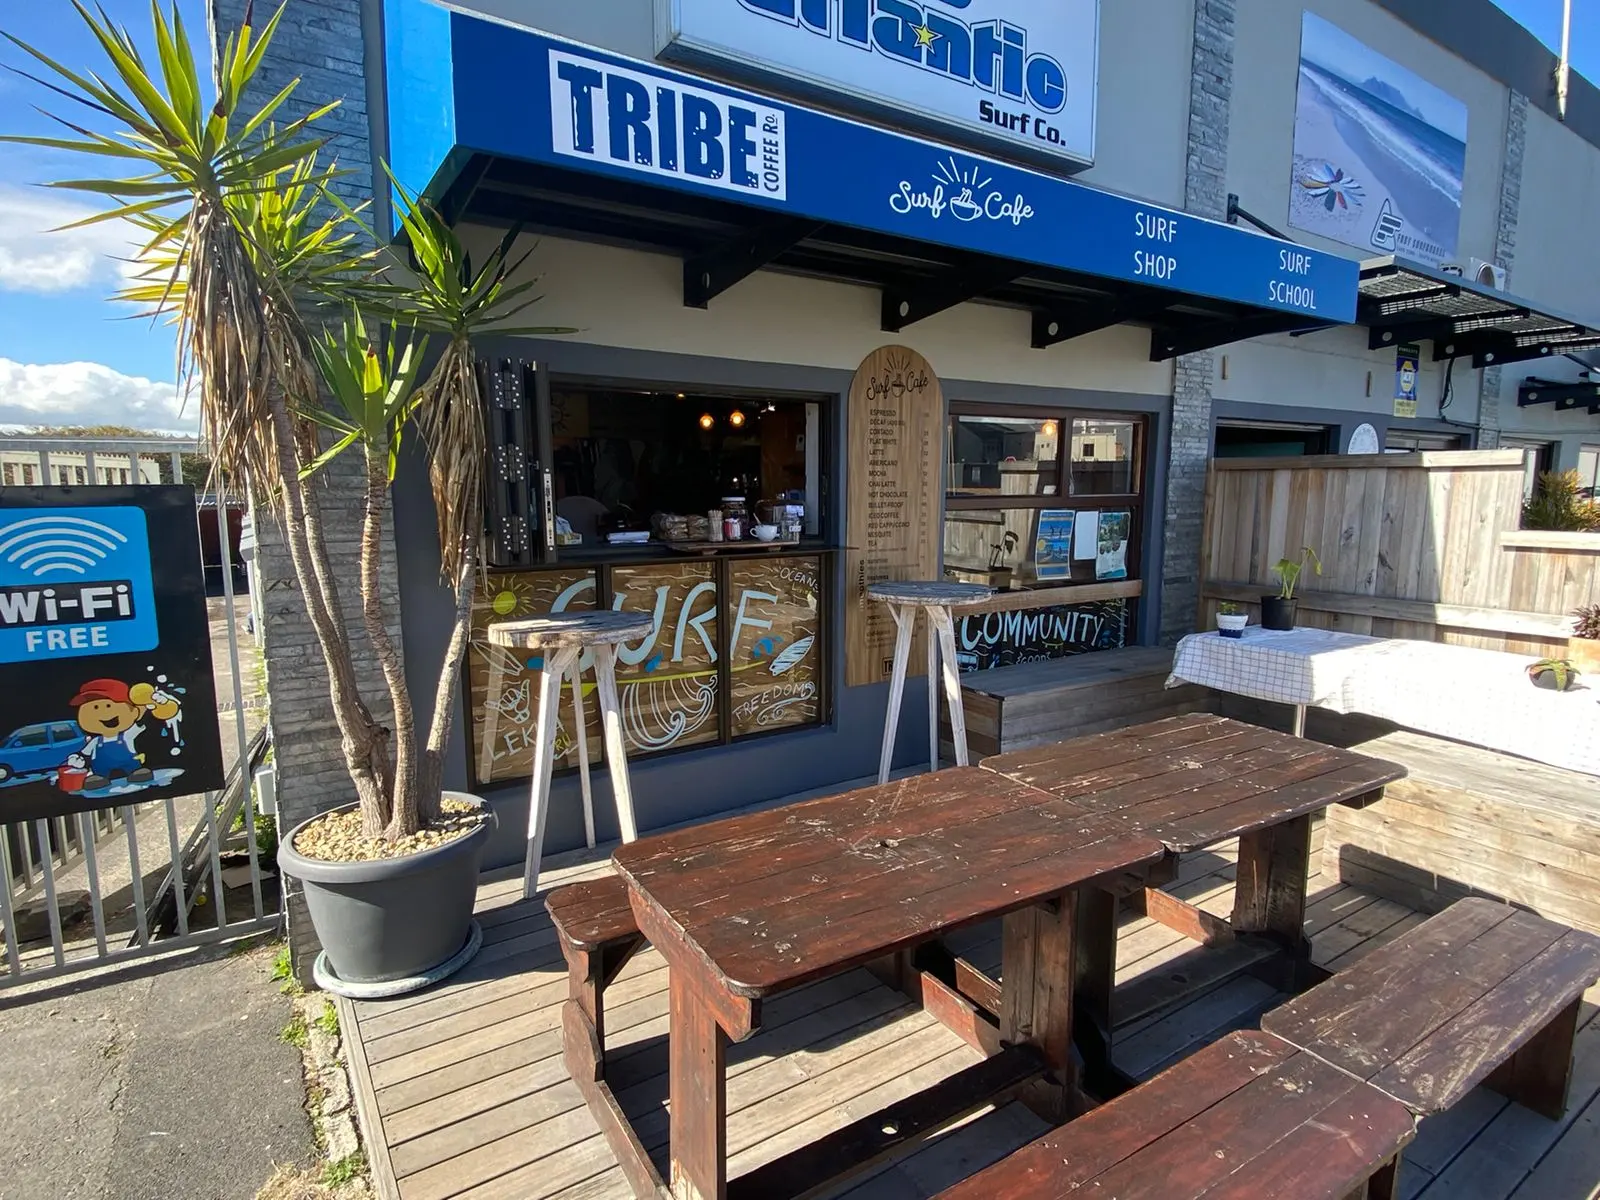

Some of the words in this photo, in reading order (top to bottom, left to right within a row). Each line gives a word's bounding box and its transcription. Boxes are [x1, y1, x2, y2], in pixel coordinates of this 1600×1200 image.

[557, 60, 759, 189] TRIBE
[979, 100, 1030, 134] Surf
[1033, 118, 1066, 146] Co.
[763, 137, 779, 192] COFFEE
[889, 180, 947, 219] Surf
[984, 191, 1035, 226] Cafe
[1134, 211, 1178, 243] SURF
[1133, 250, 1177, 280] SHOP
[1279, 249, 1312, 275] SURF
[1268, 280, 1317, 310] SCHOOL
[866, 375, 891, 400] Surf
[906, 369, 929, 394] Cafe
[0, 584, 131, 623] Wi-Fi
[26, 626, 109, 652] FREE
[960, 609, 1104, 651] COMMUNITY
